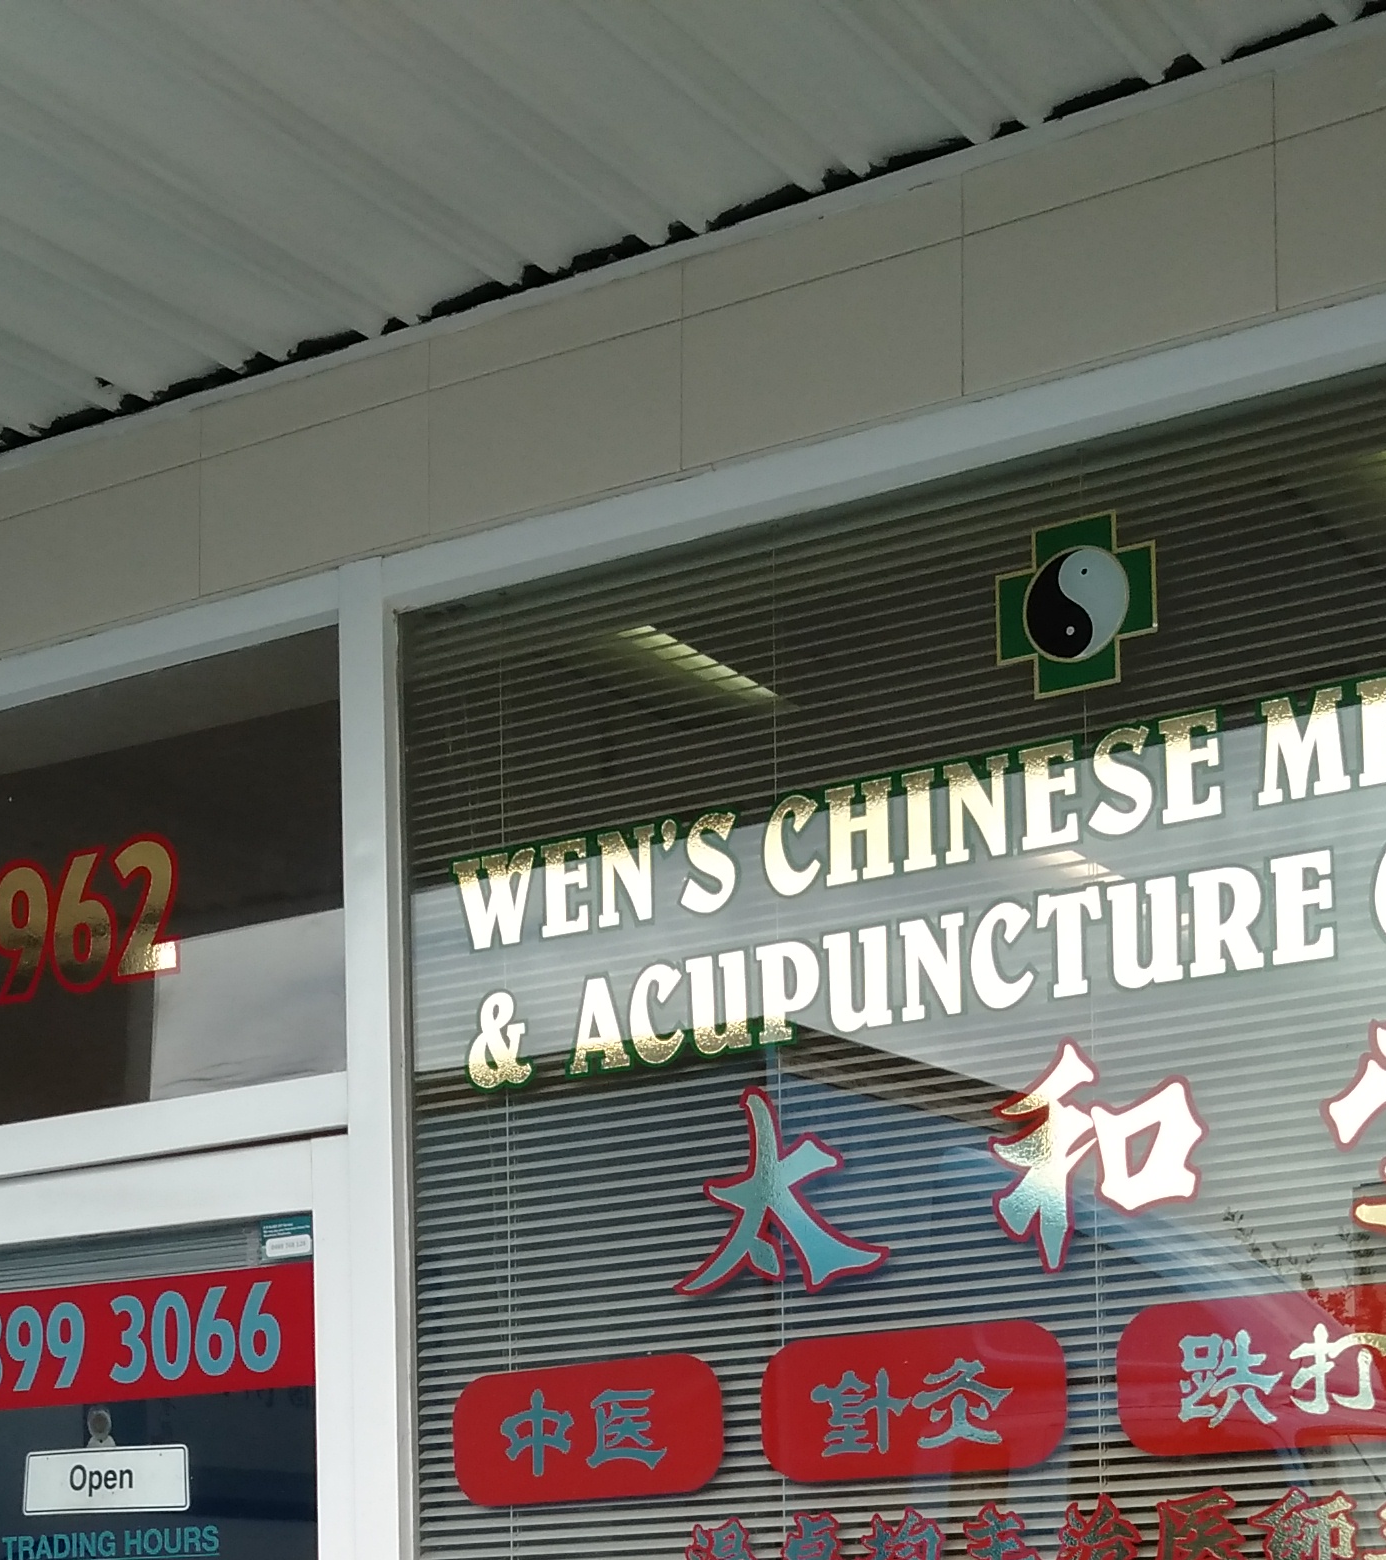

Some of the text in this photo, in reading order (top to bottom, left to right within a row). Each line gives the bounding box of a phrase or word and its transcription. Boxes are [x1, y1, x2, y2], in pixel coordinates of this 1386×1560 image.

[451, 806, 739, 951] WEN'S
[760, 709, 1223, 897] CHINESE
[465, 988, 535, 1092] &
[566, 844, 1336, 1078] ACUPUNCTURE
[108, 1281, 281, 1384] 3066
[500, 1388, 667, 1477] 中医
[811, 1357, 1013, 1457] 針灸
[69, 1464, 134, 1498] Open
[124, 1525, 220, 1557] HOURS
